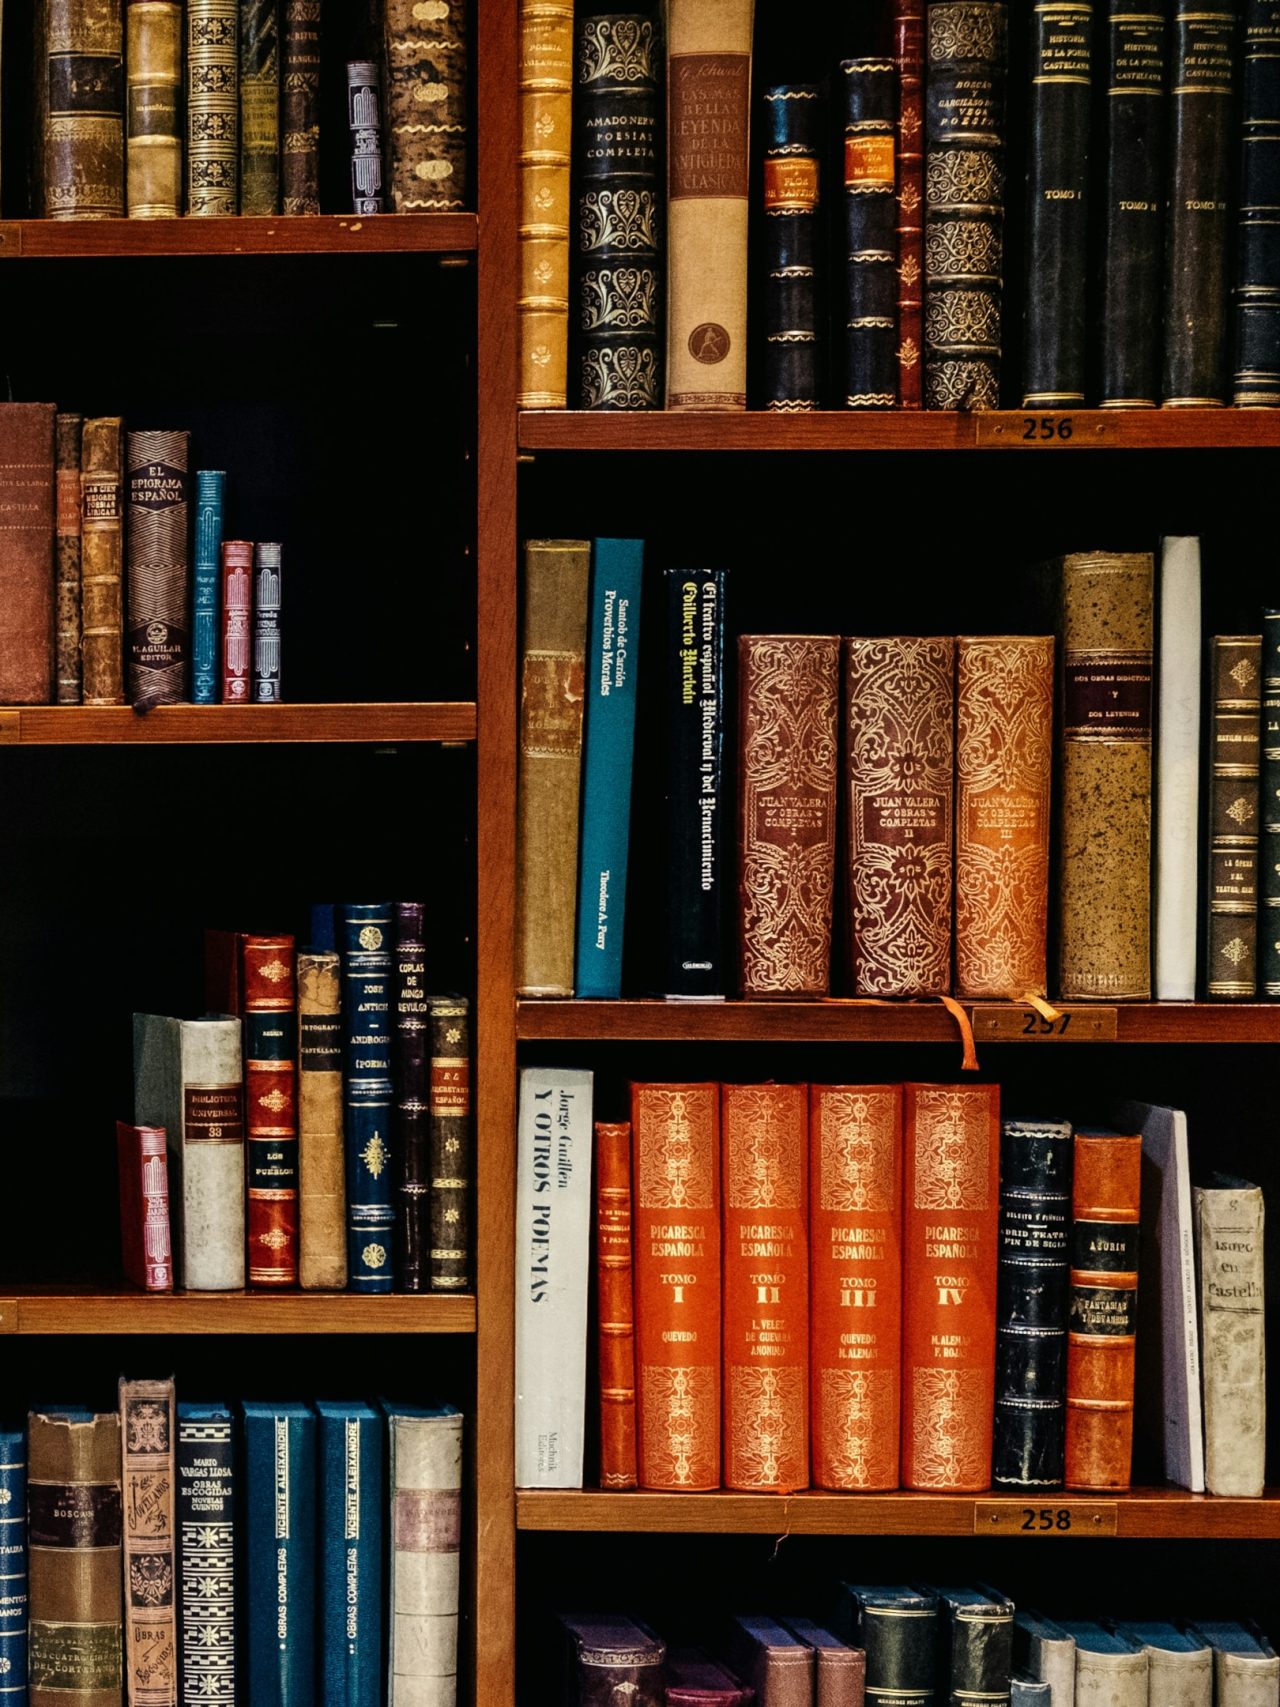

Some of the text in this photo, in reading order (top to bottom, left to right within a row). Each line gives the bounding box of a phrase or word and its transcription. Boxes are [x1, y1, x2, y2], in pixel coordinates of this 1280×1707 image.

[587, 116, 627, 126] AMADO
[1045, 190, 1074, 199] TOMO
[1120, 202, 1149, 210] TOMO
[1023, 419, 1072, 439] 256
[150, 467, 164, 476] EL
[132, 479, 183, 489] EPIGRAMA
[132, 489, 182, 501] ESPAÑOL
[601, 590, 616, 696] Proverbios Morales
[615, 599, 629, 687] Santob de Carrión
[873, 798, 940, 808] JUAN VALERA
[895, 809, 926, 817] OBRAS
[880, 818, 936, 827] COMPLETAS
[904, 829, 913, 838] II
[596, 870, 609, 950] Theodore A. Perry
[1023, 1014, 1071, 1034] 257
[557, 1090, 574, 1130] Jorge
[208, 1127, 222, 1137] 33
[531, 1090, 552, 1303] Y OTROS POEMAS
[650, 1225, 706, 1240] PICARESCA
[740, 1225, 794, 1240] PICARESCA
[651, 1242, 704, 1257] ESPAÑOLA
[740, 1242, 793, 1256] ESPAÑOLA
[831, 1244, 884, 1260] ESPAÑOLA
[926, 1243, 978, 1258] ESPAÑOLA
[660, 1275, 697, 1284] TOMO
[750, 1274, 786, 1284] TOMO
[840, 1277, 876, 1288] TOMO
[934, 1276, 969, 1287] TOMO
[672, 1286, 684, 1303] I
[756, 1286, 780, 1304] II
[840, 1290, 876, 1307] III
[936, 1288, 965, 1305] IV
[180, 1467, 208, 1476] VARGAS
[277, 1421, 286, 1538] VICENTE ALEIXANDRE
[347, 1422, 357, 1538] VICENTE ALEIXANDRE
[181, 1488, 232, 1496] ESCOGIDAS
[1021, 1510, 1071, 1530] 258
[278, 1549, 286, 1639] OBRAS COMPLETAS
[348, 1548, 357, 1639] OBRAS COMPLETAS
